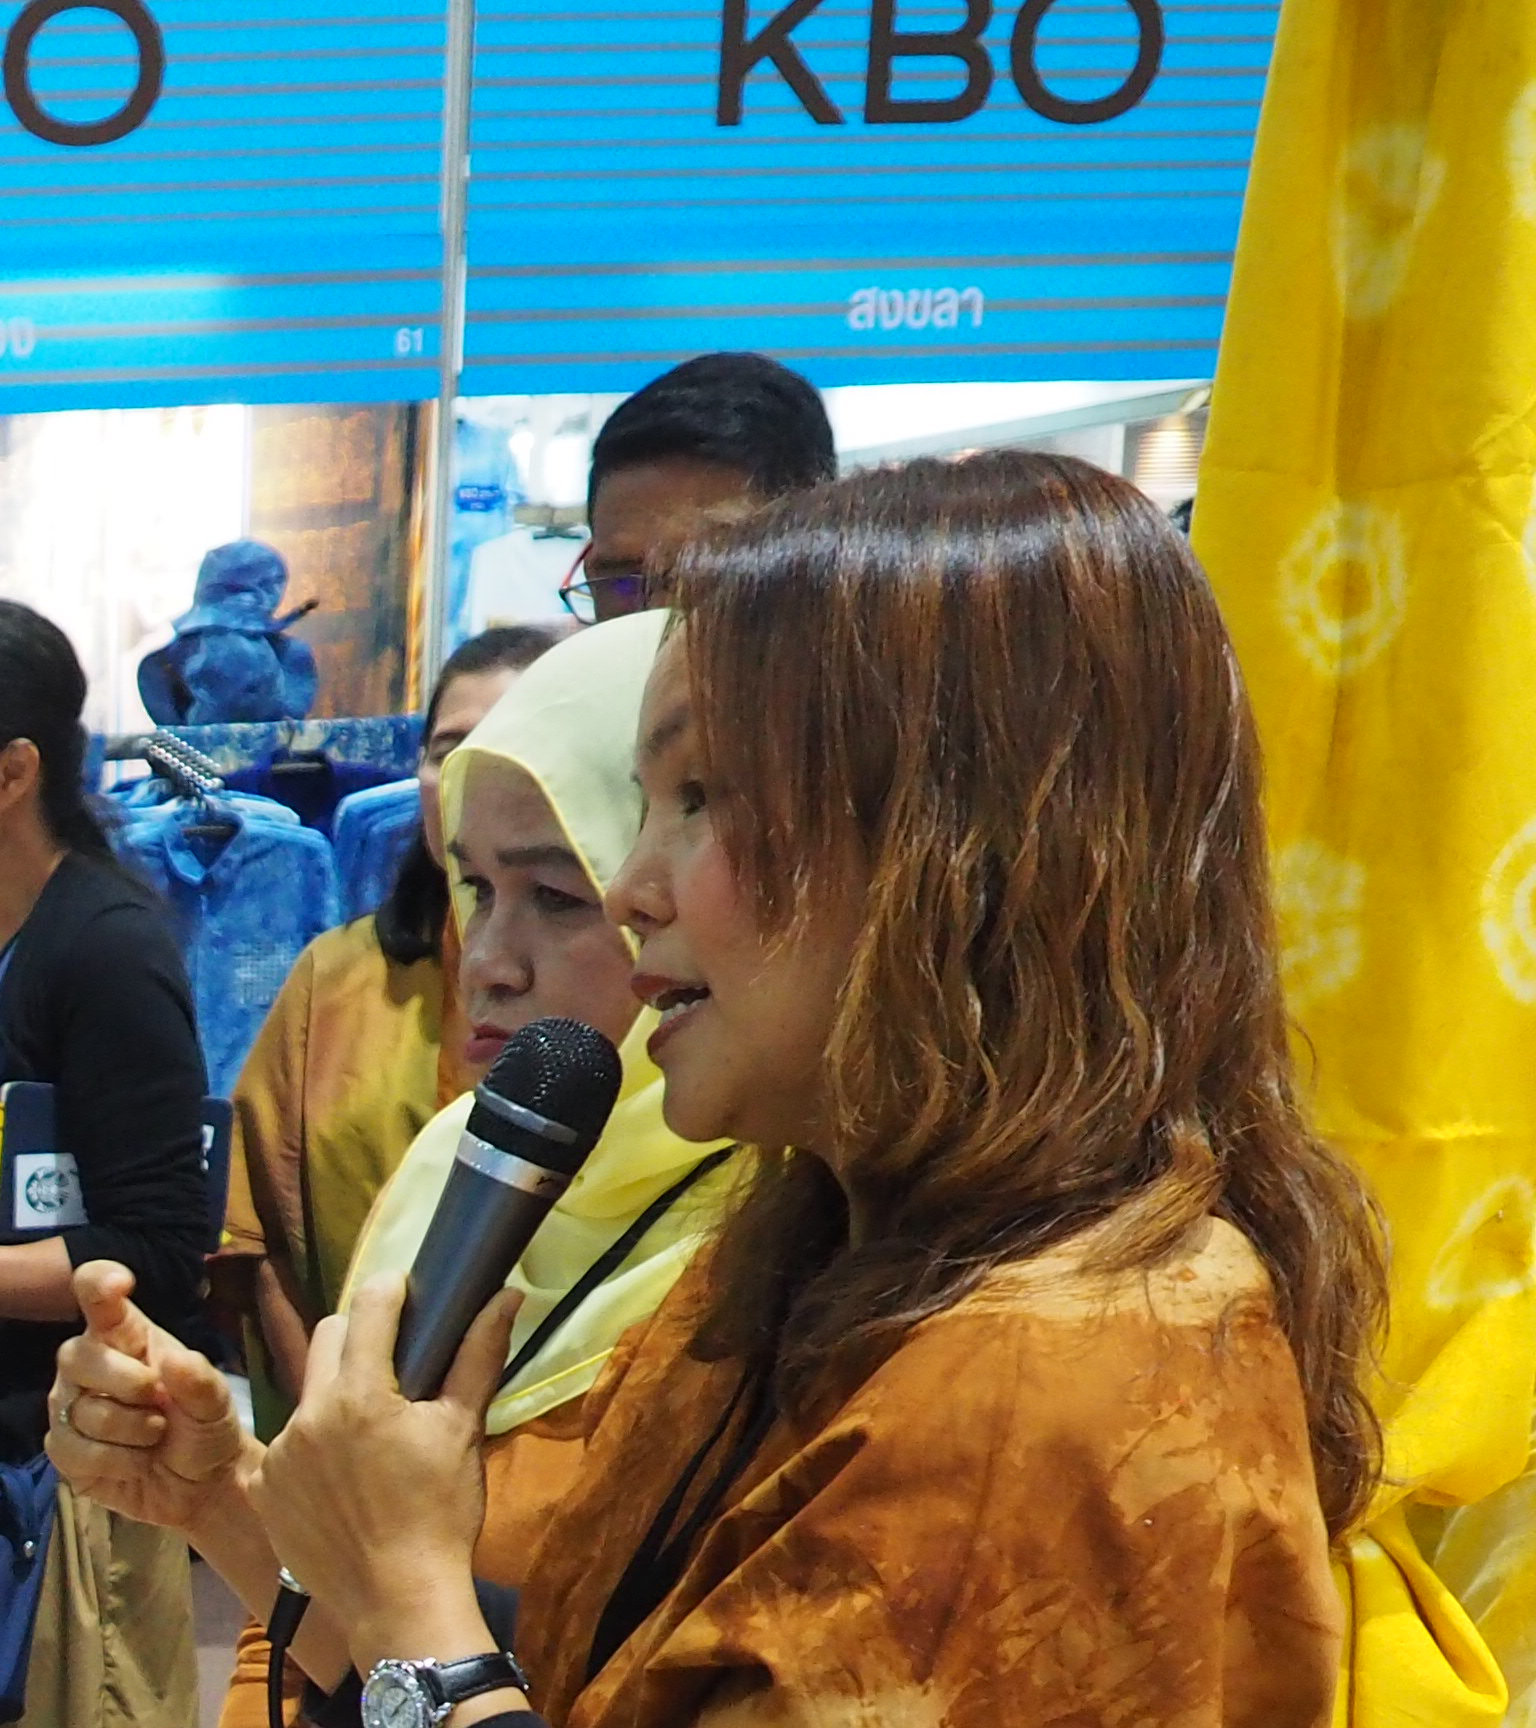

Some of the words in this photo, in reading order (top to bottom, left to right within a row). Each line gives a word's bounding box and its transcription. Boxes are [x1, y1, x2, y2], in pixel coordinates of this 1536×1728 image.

[717, 0, 1164, 126] KBO
[848, 286, 984, 331] สงขลา
[396, 327, 424, 353] 61
